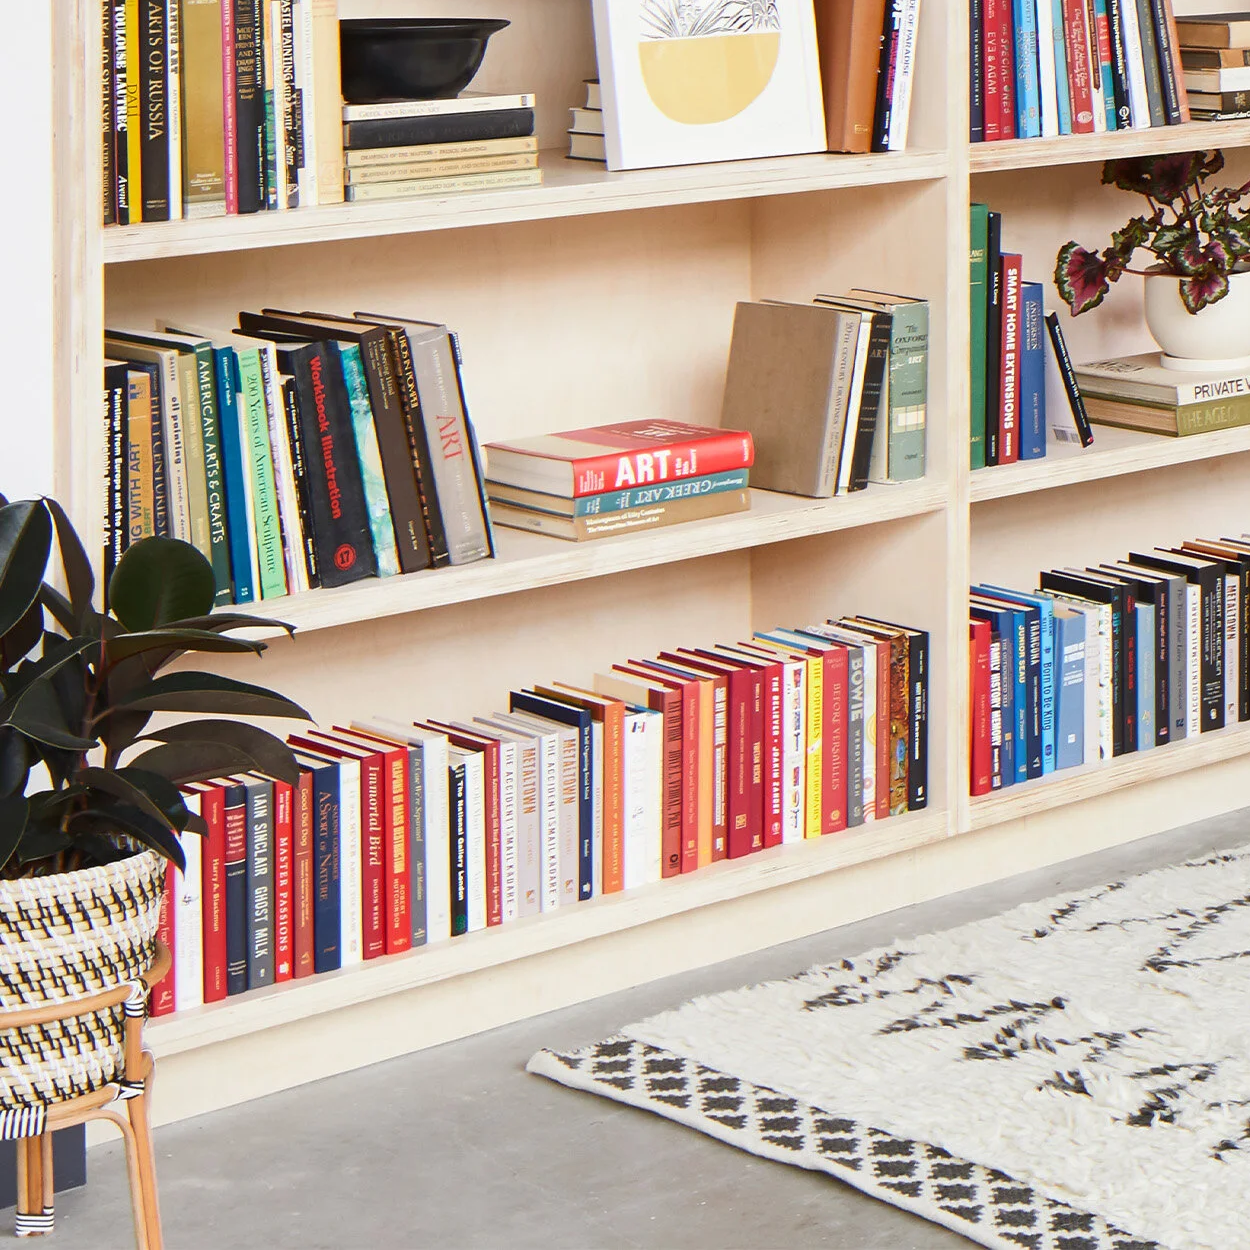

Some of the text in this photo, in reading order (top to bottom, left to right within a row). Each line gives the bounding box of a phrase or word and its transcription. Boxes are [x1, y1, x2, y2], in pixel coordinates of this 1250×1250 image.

[908, 14, 915, 27] OF
[149, 2, 163, 140] ARTS OF RUSSIA
[170, 49, 178, 74] ART
[282, 33, 293, 80] PAINTING
[902, 30, 913, 77] PARADISE
[127, 84, 138, 117] DALI
[1004, 269, 1017, 429] SMART HOME EXTENSIONS
[1030, 301, 1038, 350] ANDERSEN
[1194, 379, 1243, 399] PRIVATE
[171, 396, 183, 464] oil painting
[198, 360, 224, 543] AMERICAN ARTS & CRAFTS
[309, 356, 343, 519] Workbook Illustration
[436, 415, 463, 461] ART
[246, 374, 278, 574] 200 Years of American Sculpture
[615, 450, 672, 487] ART
[635, 479, 711, 504] GREEK ART
[1227, 585, 1236, 640] METALTOWN
[1030, 620, 1039, 665] FRANCONA
[813, 685, 821, 739] FORTUNES
[990, 642, 1001, 746] FAMILY HISTORY MEMORY
[832, 683, 841, 790] BEFORE VERSAILLES
[562, 739, 577, 804] METALTOWN
[772, 782, 780, 814] ZANDER
[300, 829, 308, 846] Dog
[369, 766, 382, 865] Immortal Bird
[392, 759, 405, 874] WEAPONS OF MASS DESTRUCTION
[547, 740, 557, 894] THE ACCIDENT ISMAIL KADARE
[254, 794, 268, 958] IAIN SINCLAIR GHOST MILK
[457, 838, 465, 867] Gallery
[280, 837, 288, 951] MASTER PASSIONS
